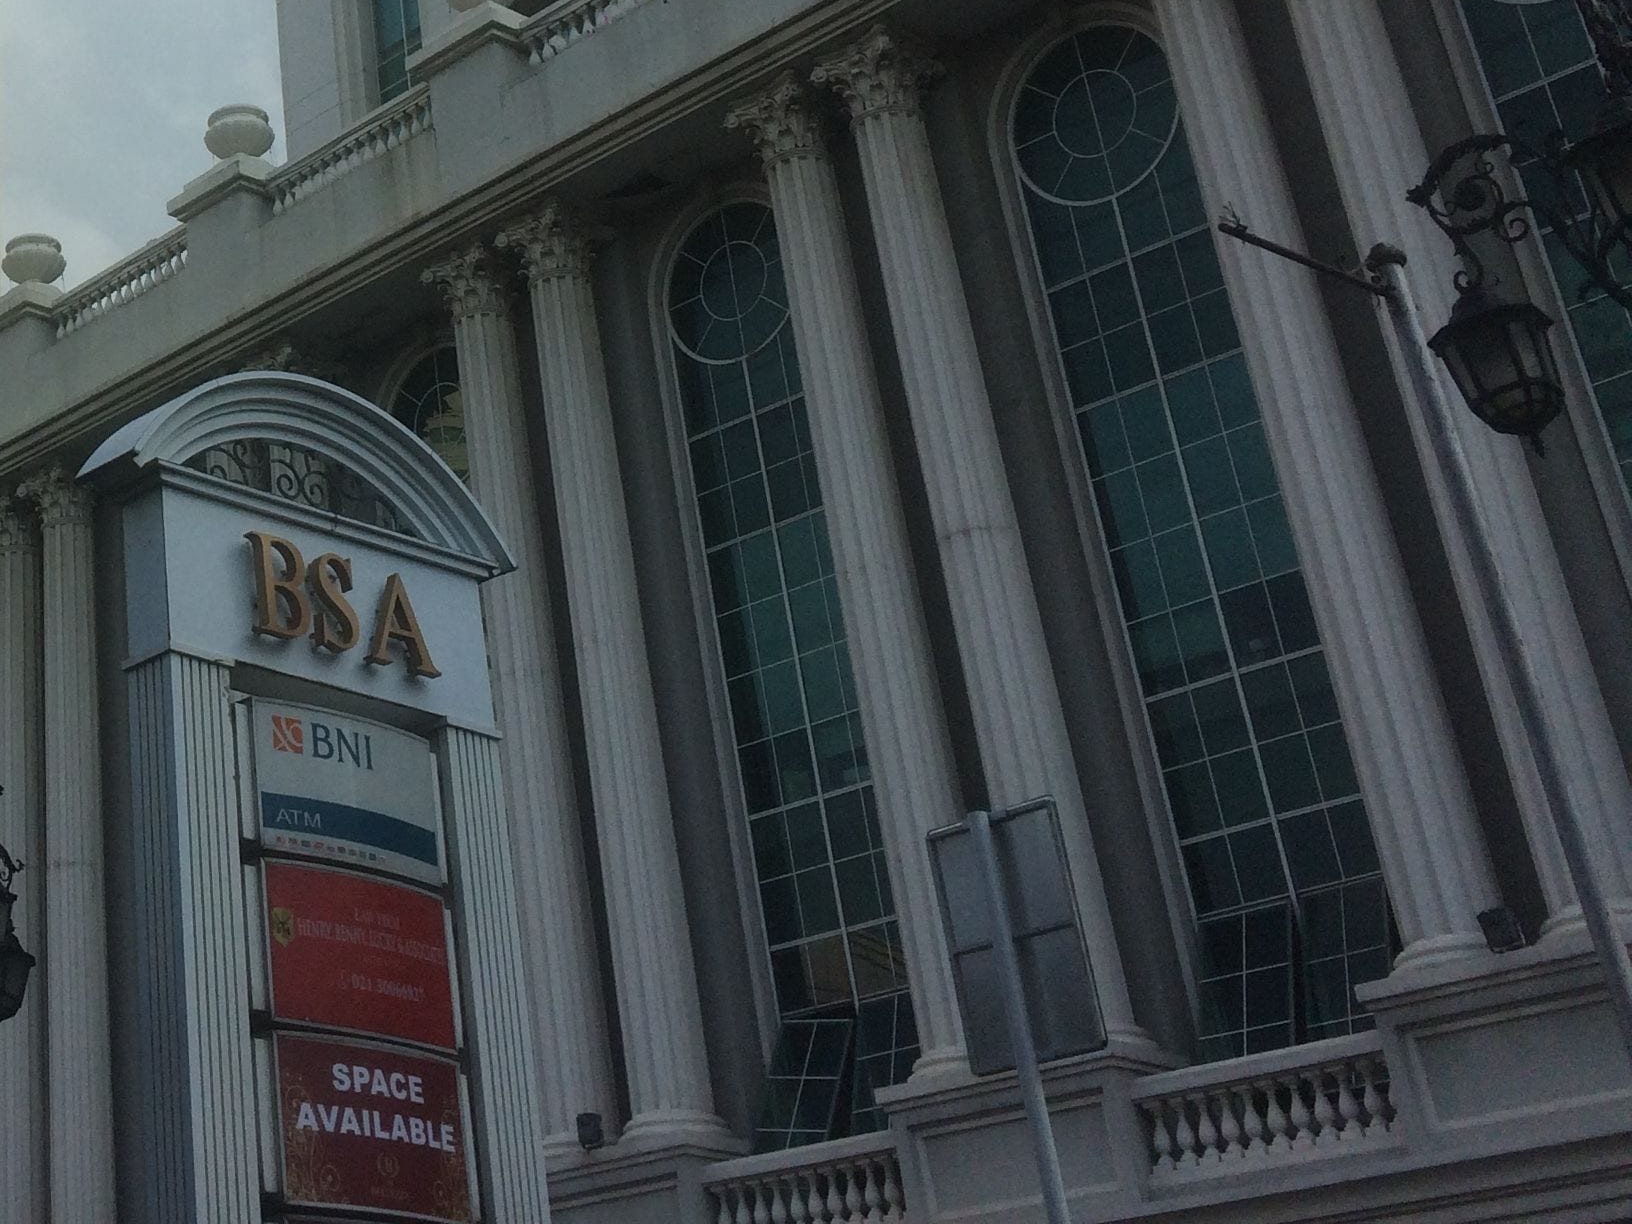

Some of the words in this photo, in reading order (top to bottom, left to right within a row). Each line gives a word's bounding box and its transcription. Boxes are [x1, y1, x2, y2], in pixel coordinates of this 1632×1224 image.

[244, 531, 442, 678] BSA
[311, 722, 373, 771] BNI
[276, 807, 321, 829] ATM
[332, 1063, 425, 1104] SPACE
[296, 1101, 456, 1153] AVAILABLE
